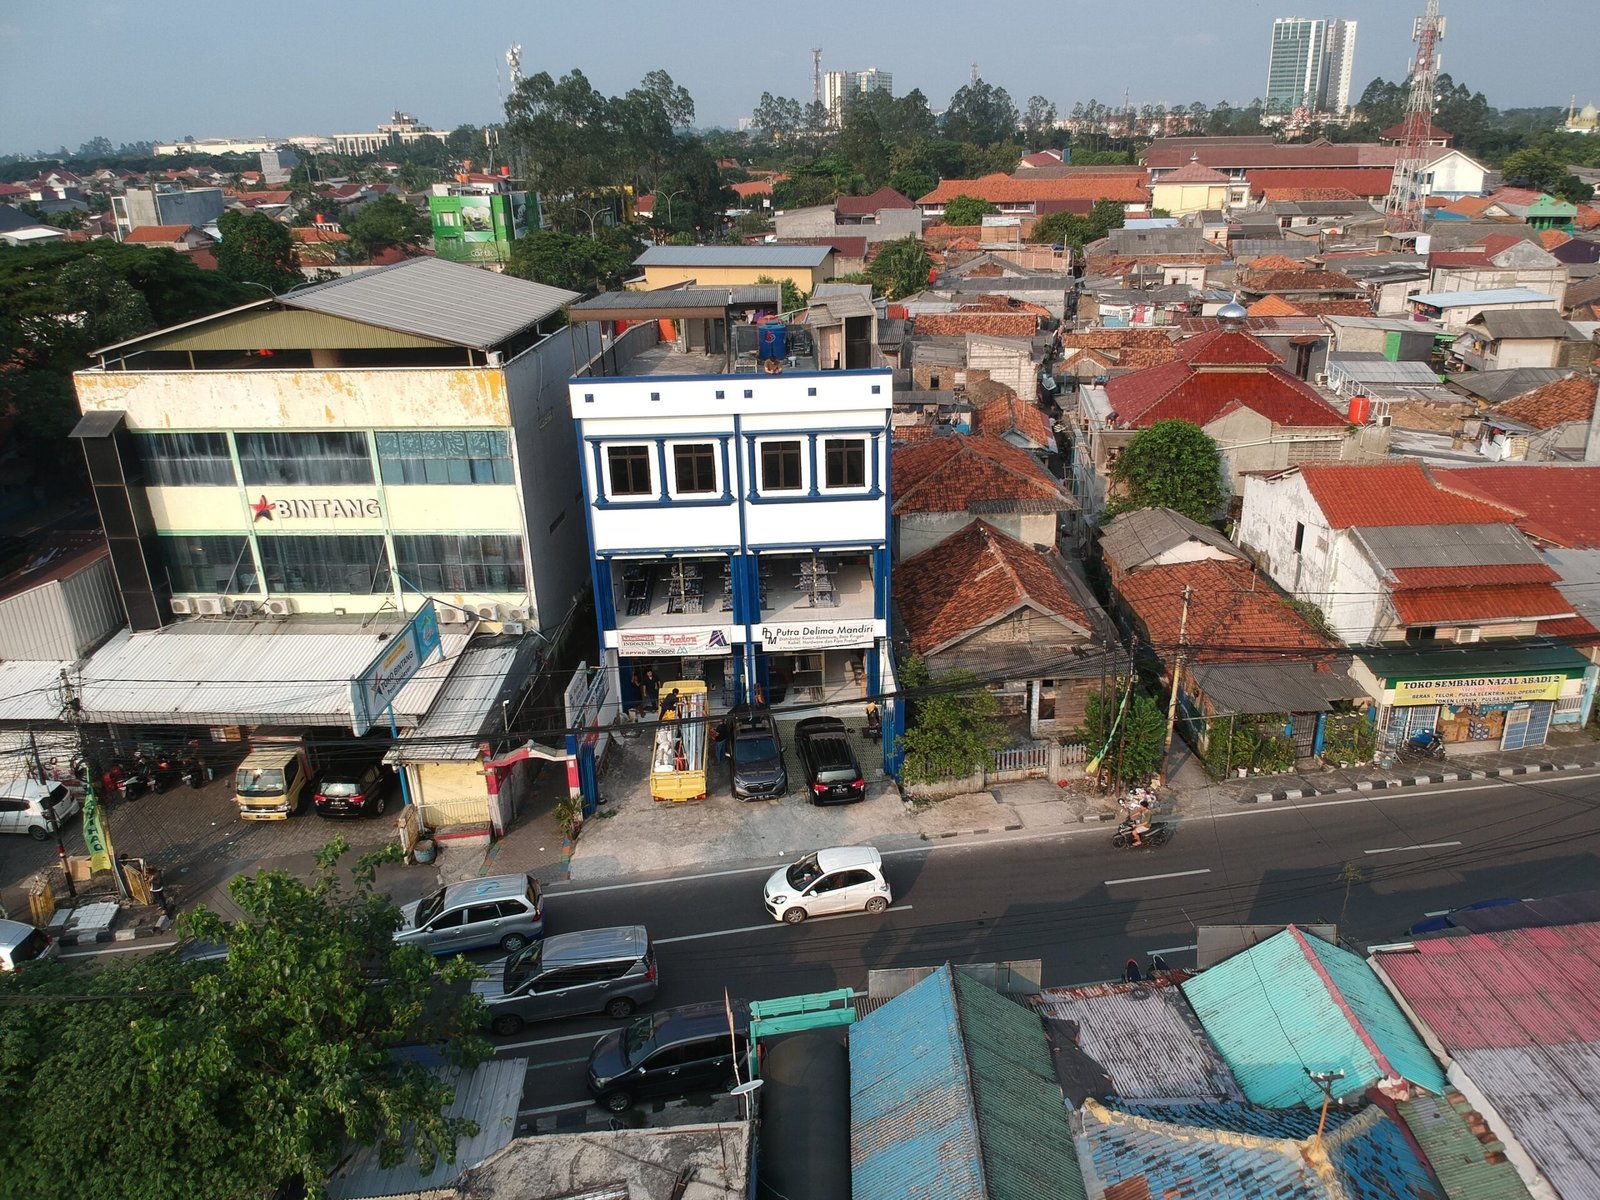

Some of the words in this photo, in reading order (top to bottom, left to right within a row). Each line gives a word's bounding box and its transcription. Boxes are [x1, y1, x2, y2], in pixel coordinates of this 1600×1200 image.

[275, 499, 382, 518] BINTANG
[776, 628, 799, 637] Putra
[802, 627, 834, 636] Delima
[837, 625, 873, 634] Mandiri
[393, 650, 414, 676] BINTANG
[1403, 680, 1432, 689] TOKO
[1434, 678, 1485, 689] SEMBAKO
[1486, 677, 1519, 688] NAZAL
[1520, 676, 1552, 686] ABADI
[1553, 675, 1560, 683] 2
